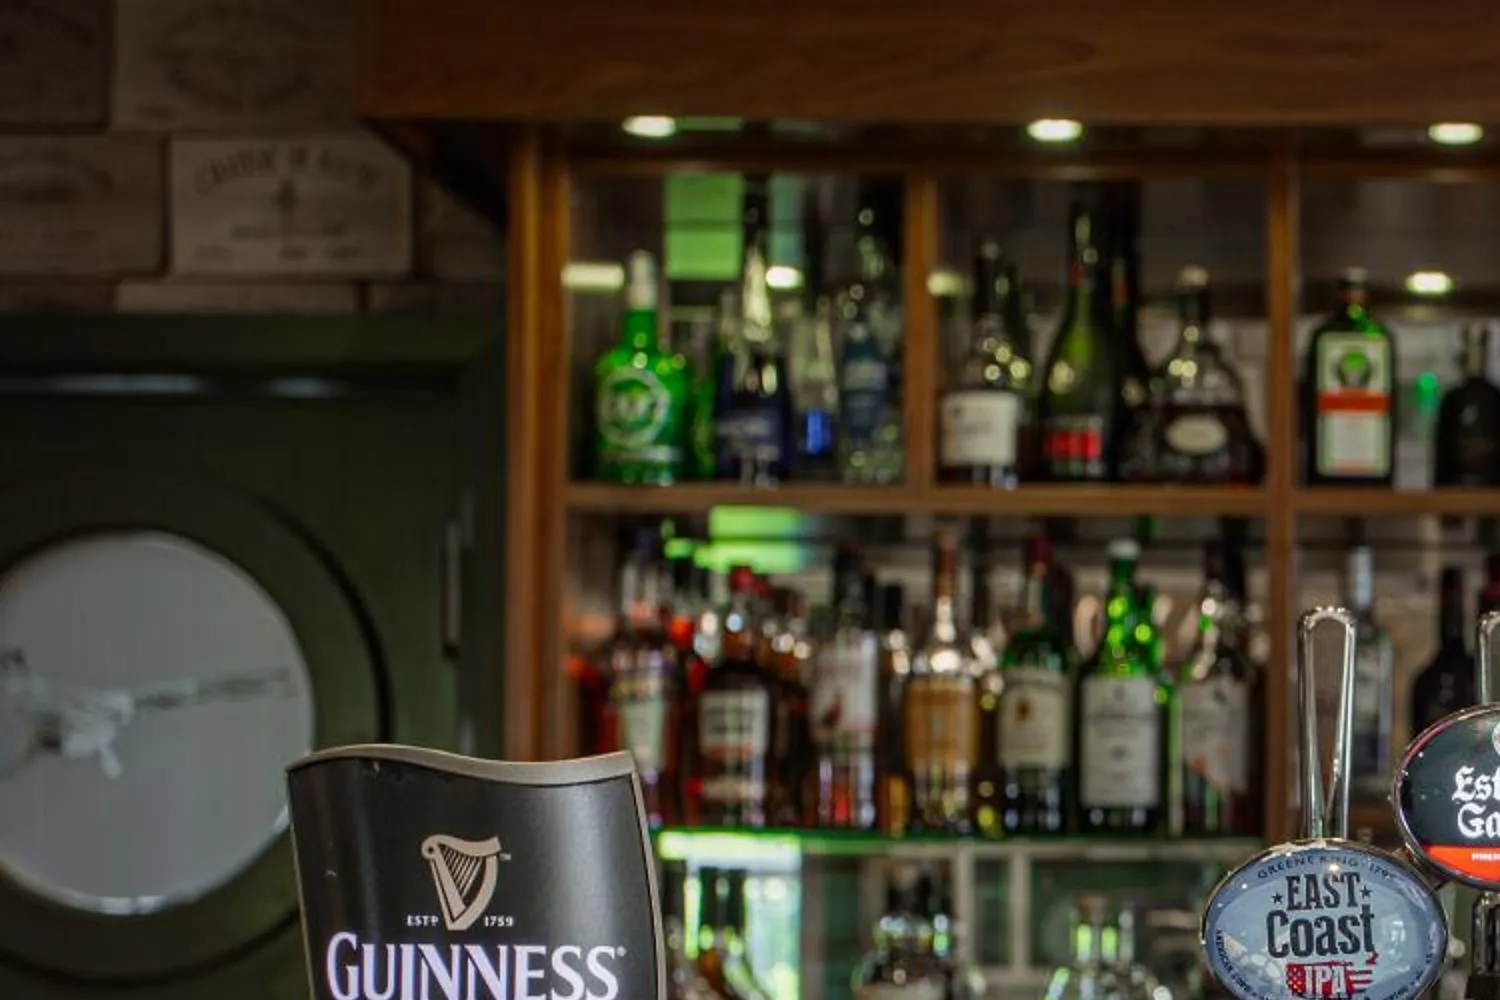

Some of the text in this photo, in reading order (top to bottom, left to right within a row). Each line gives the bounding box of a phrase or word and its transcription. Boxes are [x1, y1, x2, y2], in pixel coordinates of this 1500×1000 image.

[1257, 854, 1316, 880] GREENE
[1285, 871, 1361, 911] EAST
[484, 915, 515, 928] 1759
[1265, 904, 1376, 958] Coast
[1303, 963, 1348, 1000] IPA
